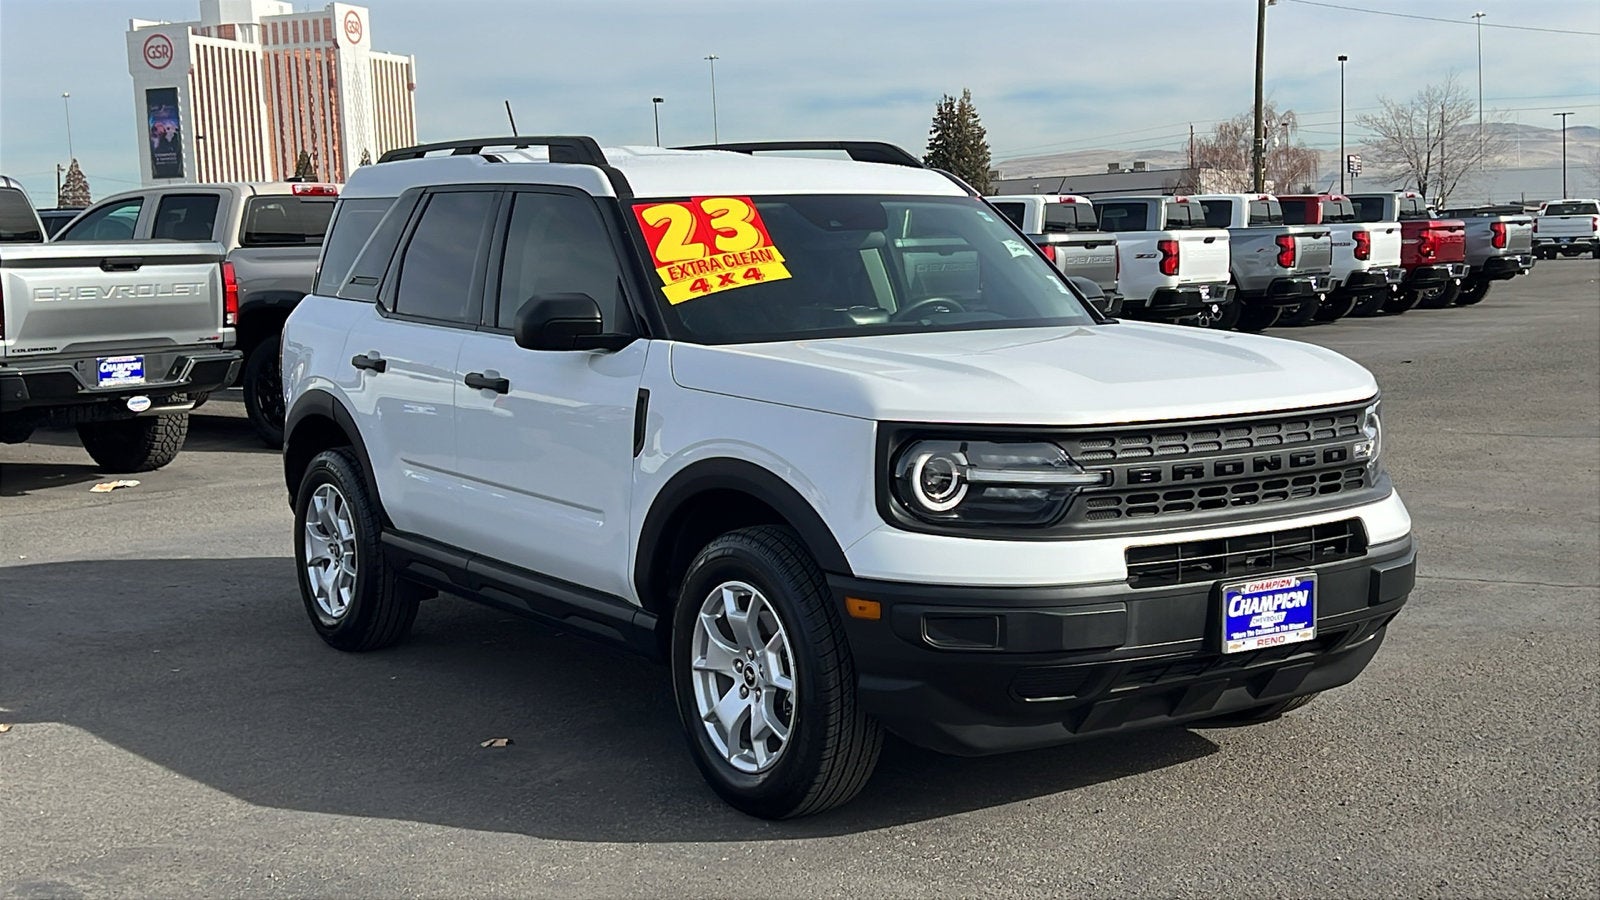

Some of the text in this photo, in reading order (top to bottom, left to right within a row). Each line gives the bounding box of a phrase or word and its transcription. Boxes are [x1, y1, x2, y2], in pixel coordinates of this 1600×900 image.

[347, 20, 360, 34] GSR
[147, 45, 169, 59] GSR
[641, 197, 764, 263] 23
[667, 248, 775, 282] EXTRA CLEAN
[33, 282, 206, 301] CHEVROLET
[1127, 447, 1347, 485] BRONCO
[1249, 579, 1292, 592] CHAMPION
[1228, 590, 1309, 618] CHAMPION
[1253, 614, 1283, 624] CHEVROLET
[1256, 635, 1286, 647] RENO
